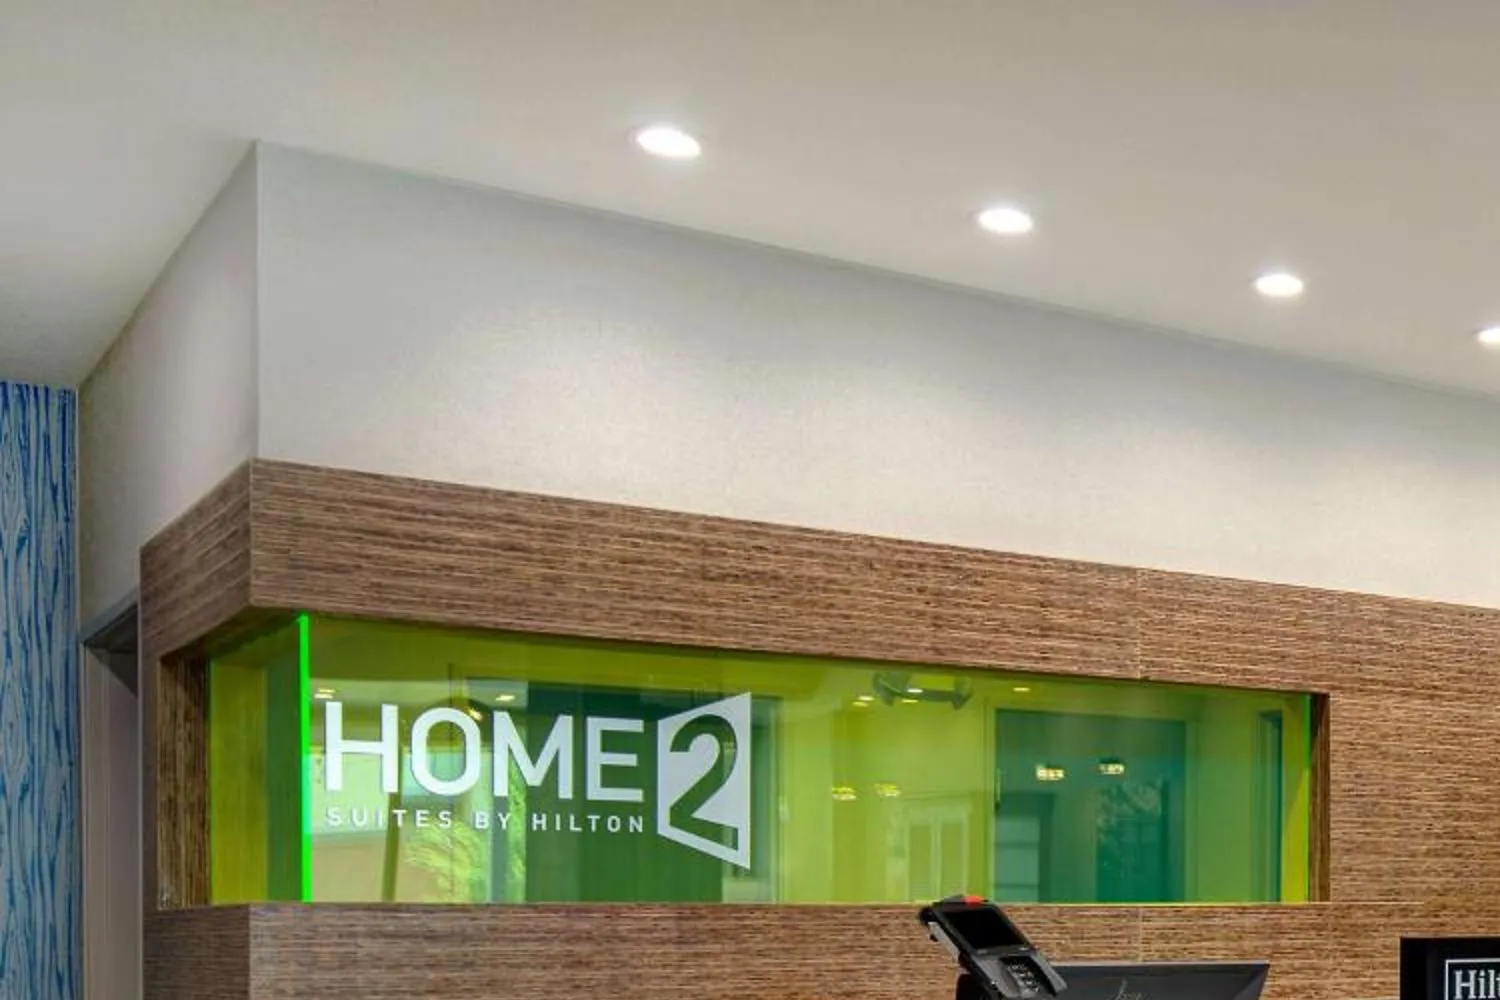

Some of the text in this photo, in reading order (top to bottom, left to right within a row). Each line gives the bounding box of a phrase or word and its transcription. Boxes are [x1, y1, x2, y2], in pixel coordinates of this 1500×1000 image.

[325, 701, 742, 854] HOME 2
[326, 807, 644, 833] SUITES BY HILTON
